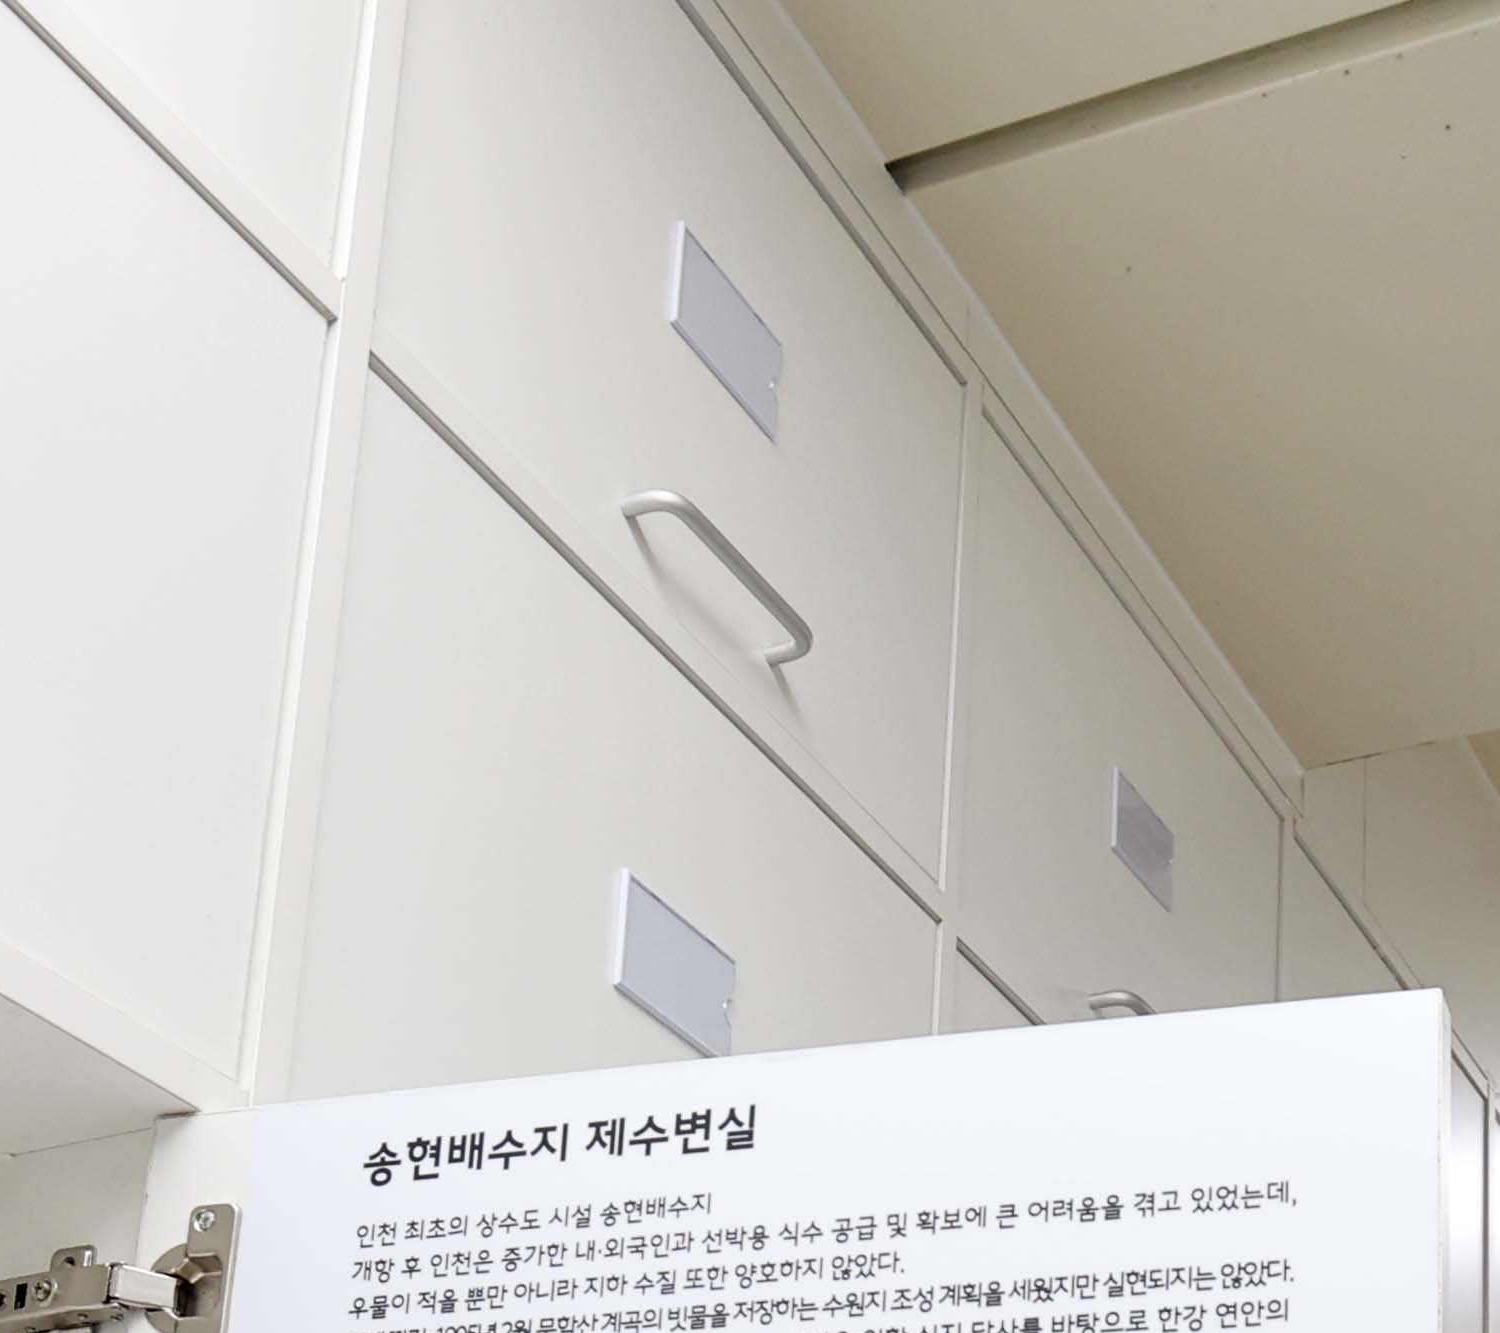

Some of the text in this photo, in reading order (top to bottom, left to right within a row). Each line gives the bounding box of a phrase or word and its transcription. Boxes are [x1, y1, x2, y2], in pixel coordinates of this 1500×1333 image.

[363, 1104, 756, 1187] 송현배수지 제수변실
[352, 1181, 1296, 1283] 개항 후 인천은 증가한 내·외국인과 선박용 식수 공급 및 확보에 큰 어려움을 겪고 있었는데,
[357, 1192, 711, 1248] 인천 최초의 상수도 시설 송현배수지
[348, 1251, 904, 1320] 우물이 적을 뿐만 아니라 지하 수질 또한 양호하지 않았다.
